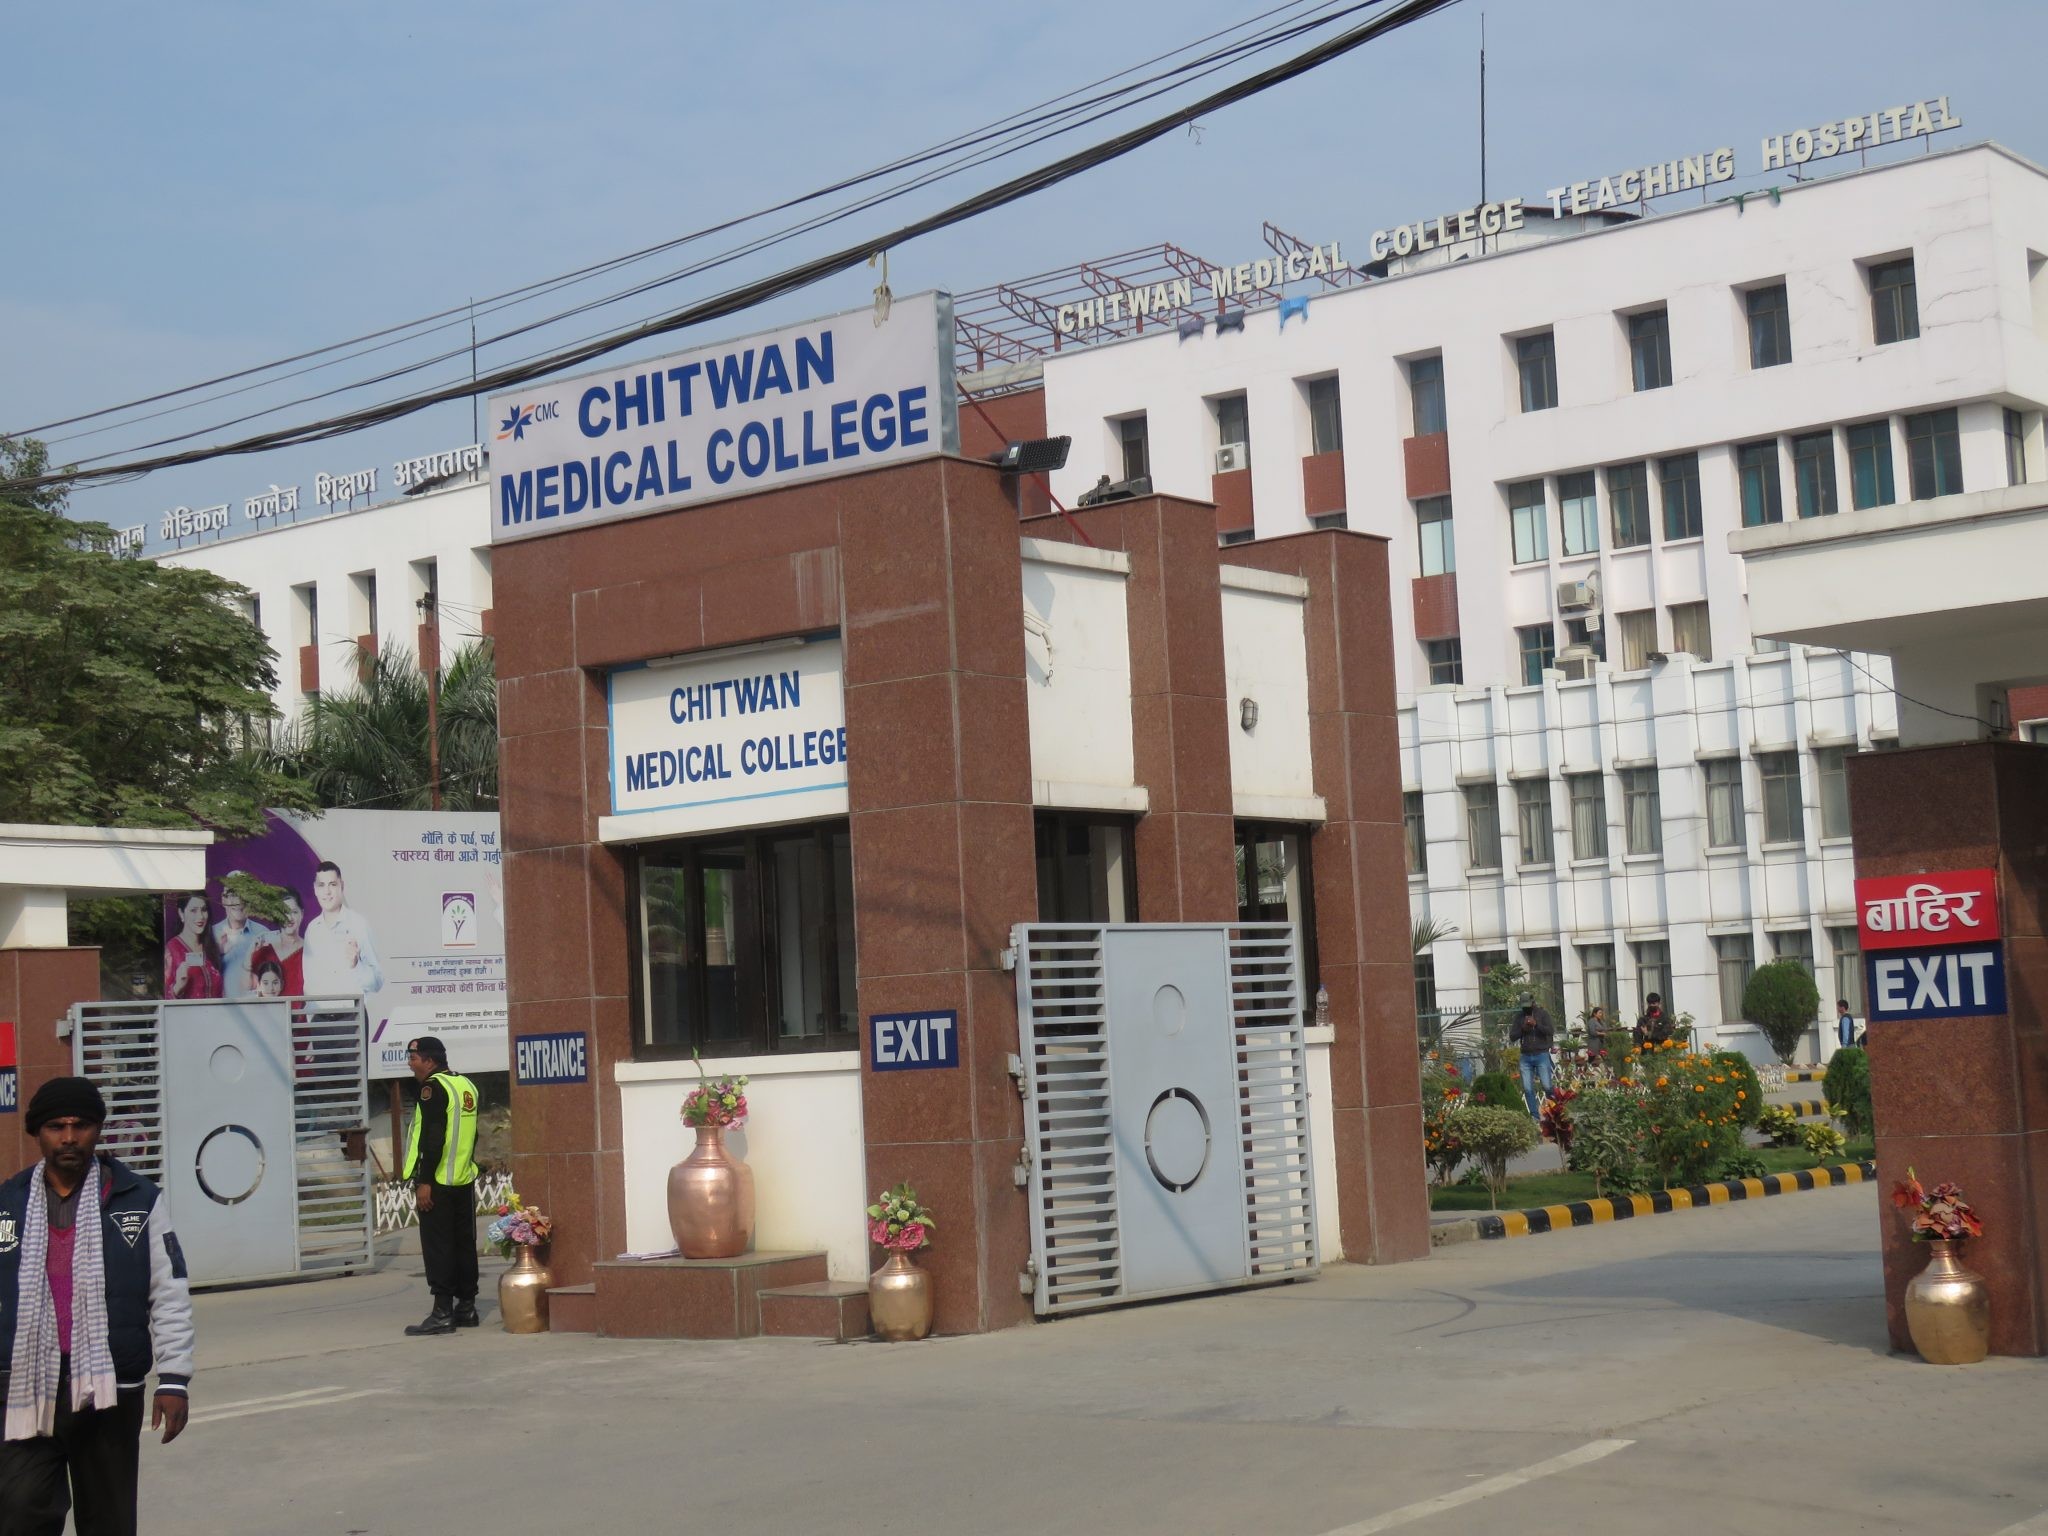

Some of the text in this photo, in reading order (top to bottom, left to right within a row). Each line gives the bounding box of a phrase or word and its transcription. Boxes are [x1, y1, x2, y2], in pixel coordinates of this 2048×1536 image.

[1058, 96, 1962, 333] CHITWAN MEDICAL COLLEGE TEACHING HOSPITAL
[535, 400, 560, 422] CMC
[578, 330, 835, 438] CHITWAN
[501, 385, 929, 526] MEDICAL COLLEGE
[160, 506, 231, 540] मेडिकल
[244, 484, 300, 519] कलेज
[314, 468, 378, 505] शिक्षण
[392, 443, 484, 487] अस्पताल
[669, 670, 801, 725] CHITWAN
[625, 726, 847, 792] MEDICAL COLLEGE
[1864, 883, 1981, 932] बाहिर
[1875, 952, 1994, 1011] EXIT
[517, 1038, 586, 1079] ENTRANCE
[875, 1017, 952, 1063] EXIT
